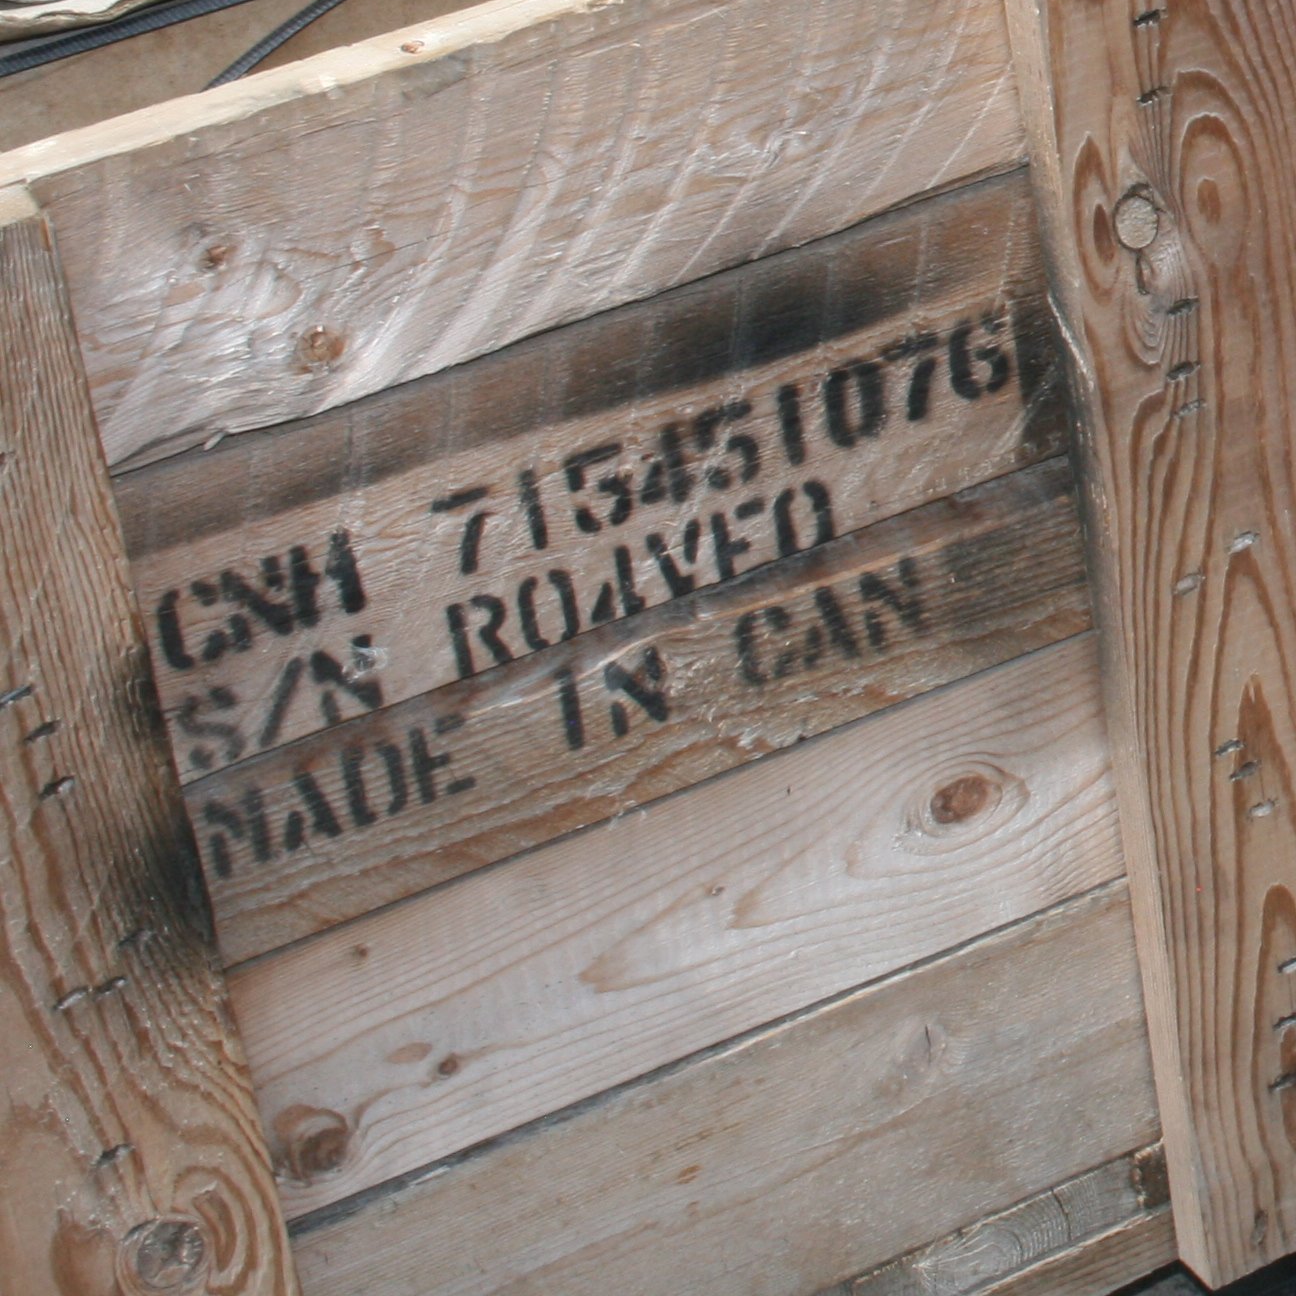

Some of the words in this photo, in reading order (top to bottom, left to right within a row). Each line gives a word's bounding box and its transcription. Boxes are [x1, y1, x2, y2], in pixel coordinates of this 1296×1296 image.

[176, 632, 385, 771] S/N
[203, 712, 477, 880] MADE
[554, 646, 669, 751] IN
[733, 556, 926, 687] CAN
